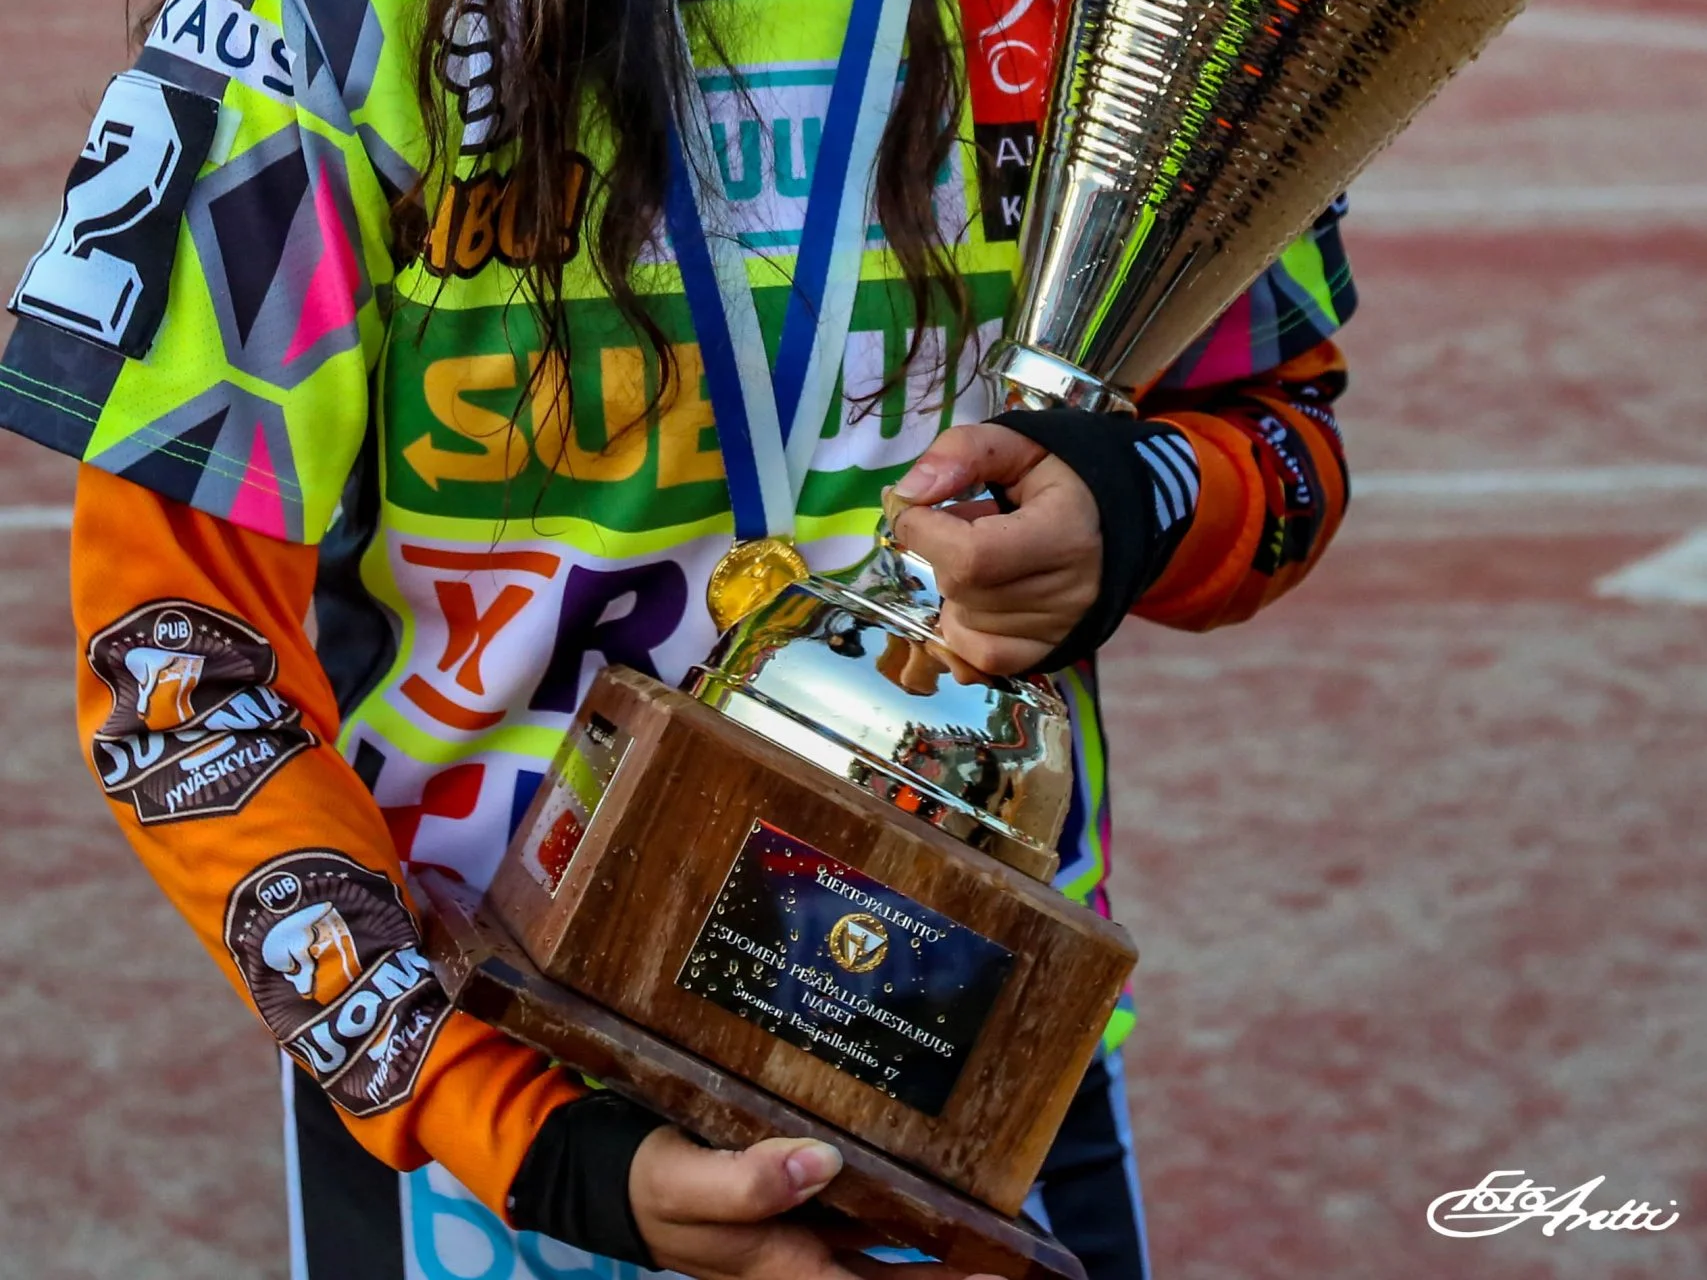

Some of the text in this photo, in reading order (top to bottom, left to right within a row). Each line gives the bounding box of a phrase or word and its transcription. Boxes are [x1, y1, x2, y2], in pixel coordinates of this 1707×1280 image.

[12, 75, 184, 348] 2
[157, 620, 190, 641] PUB
[165, 737, 277, 814] JYVÄSKYLÄ
[259, 876, 299, 907] PUB
[815, 871, 940, 944] KIERTOPALKINTO
[717, 925, 956, 1058] SUOMEN PESÄPALLOMESTARUUS
[732, 980, 784, 1020] Suomen
[790, 1012, 879, 1069] Pesäpalloliitto
[800, 991, 856, 1027] NAISET
